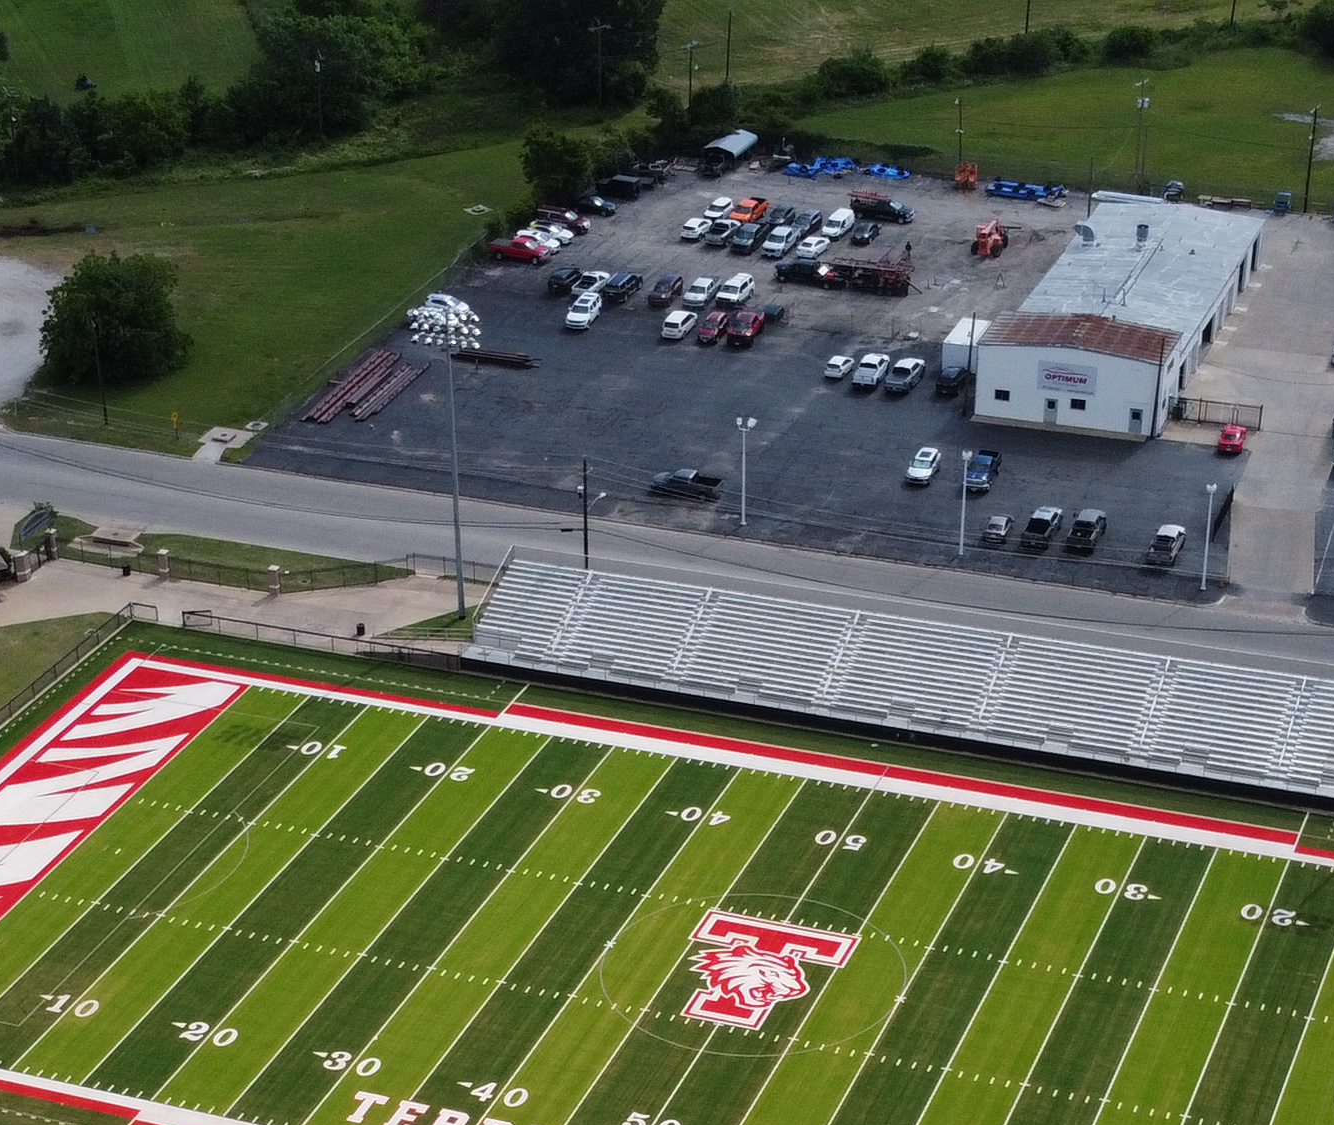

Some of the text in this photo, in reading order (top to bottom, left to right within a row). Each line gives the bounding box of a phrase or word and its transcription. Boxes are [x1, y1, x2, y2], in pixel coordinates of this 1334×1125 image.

[1044, 373, 1088, 385] OPTIMUM
[300, 741, 347, 759] 10
[424, 762, 475, 781] 20
[550, 784, 601, 804] 30
[680, 806, 731, 826] 40
[814, 829, 867, 852] 50
[952, 853, 1005, 875] 40
[1094, 878, 1148, 901] 30
[1240, 903, 1296, 926] 20
[45, 994, 100, 1018] 10
[178, 1021, 239, 1047] 20
[323, 1051, 382, 1077] 30
[470, 1082, 529, 1107] 40
